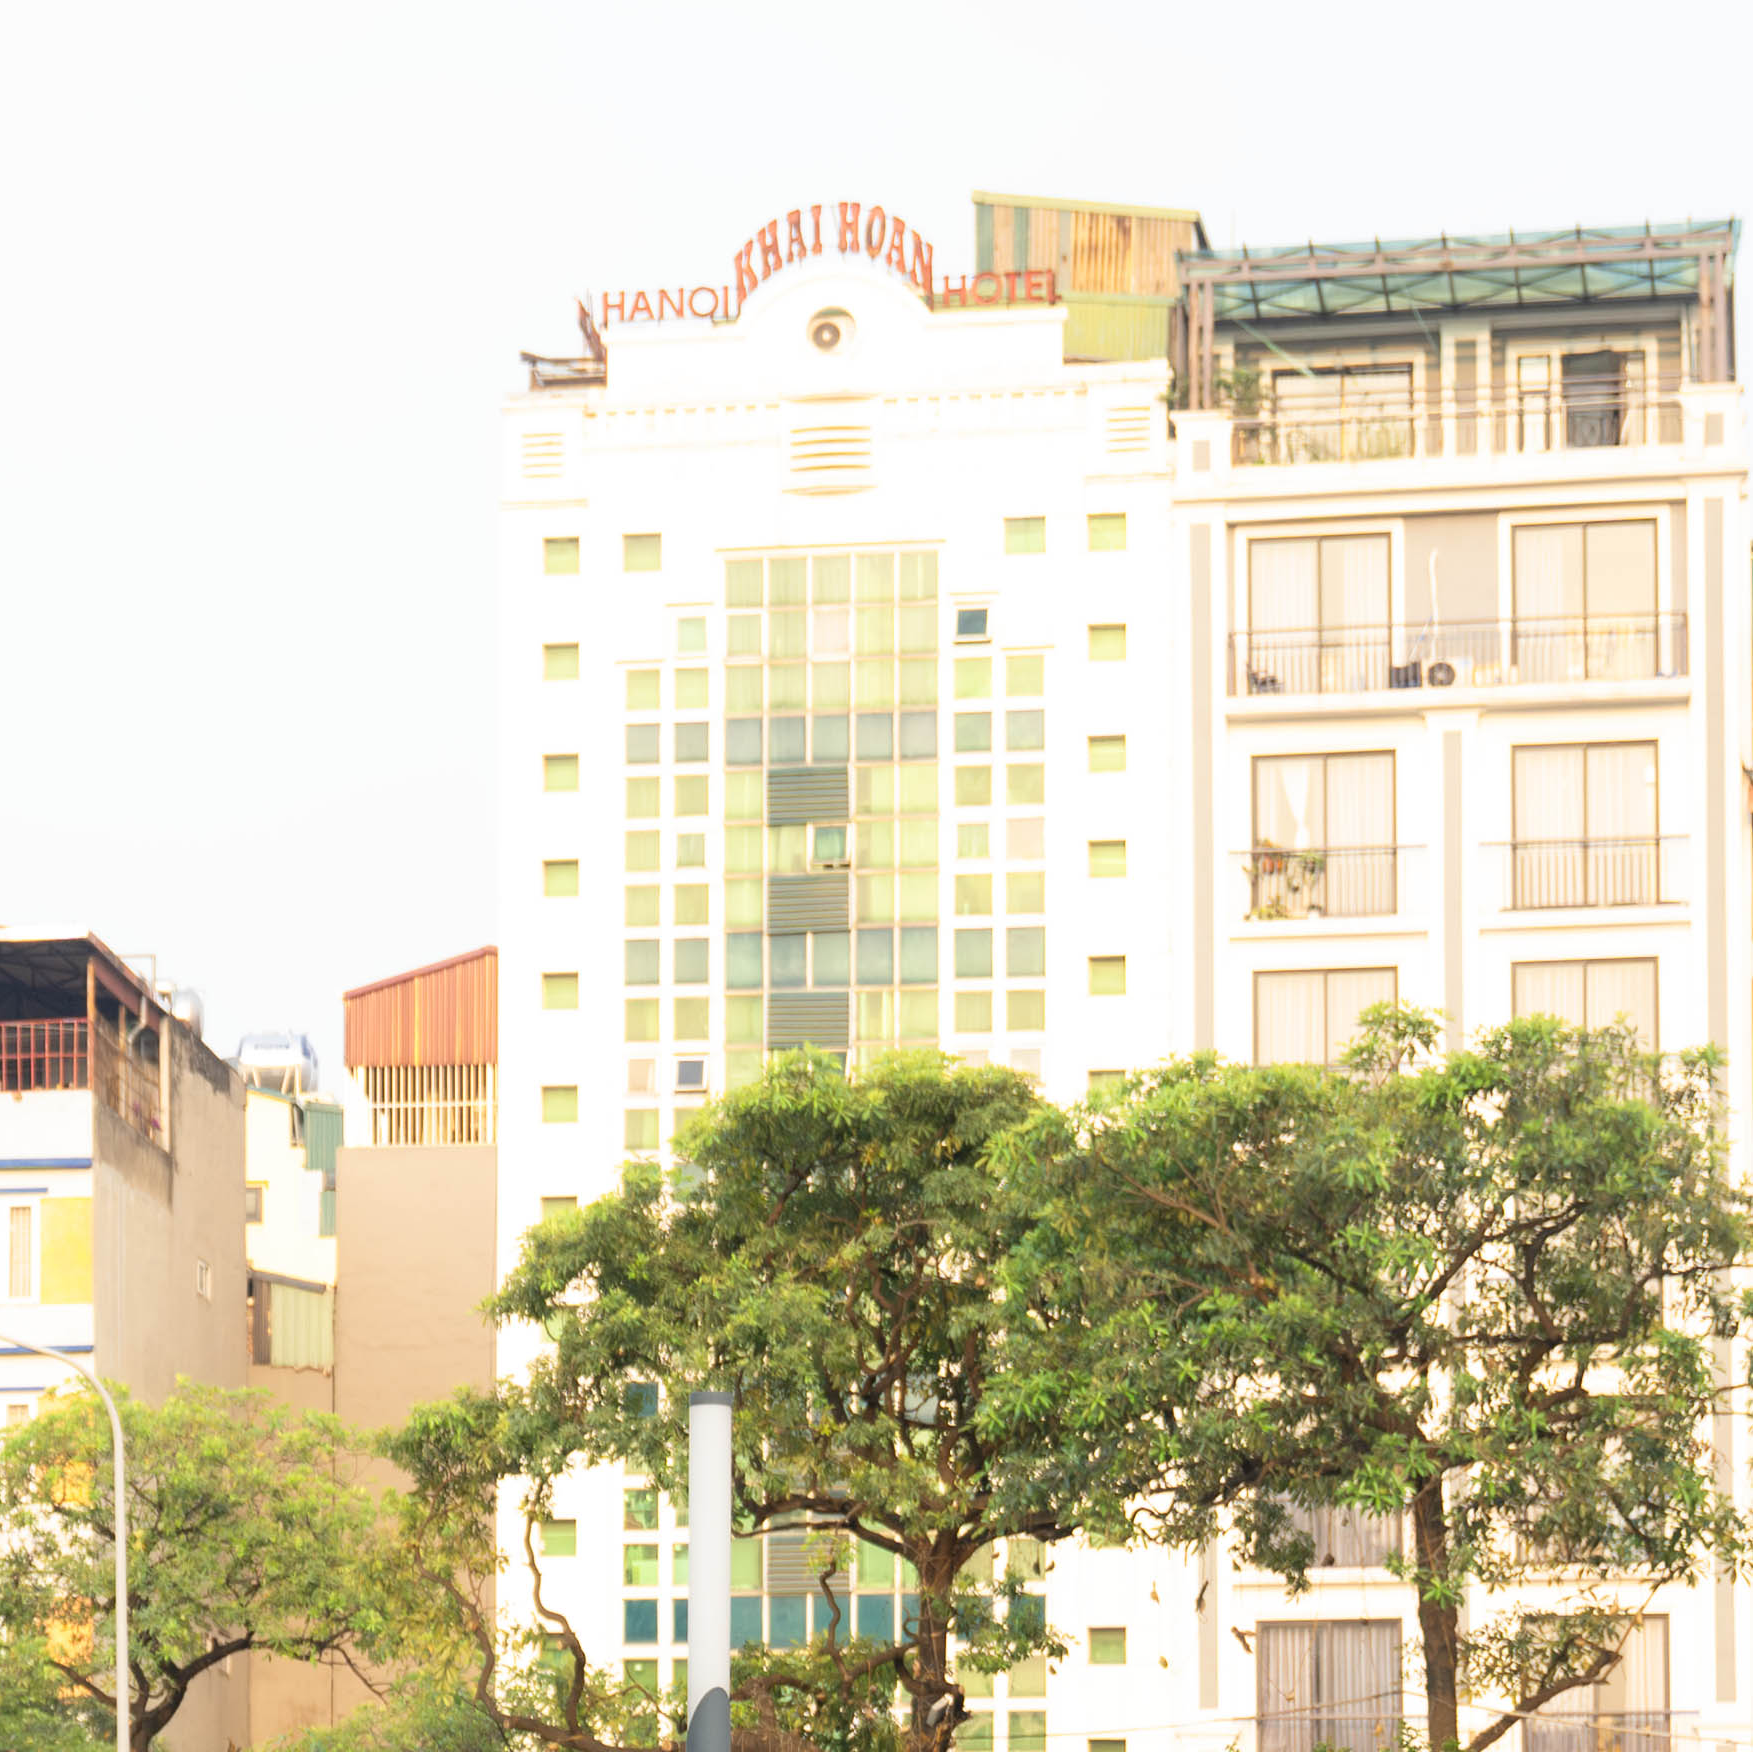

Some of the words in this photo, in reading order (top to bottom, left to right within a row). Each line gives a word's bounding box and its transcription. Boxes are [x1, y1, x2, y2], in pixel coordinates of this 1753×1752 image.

[734, 204, 823, 305] KHAI
[838, 202, 934, 312] HOAN
[602, 286, 729, 321] HANOI
[942, 269, 1062, 306] HOTEL
